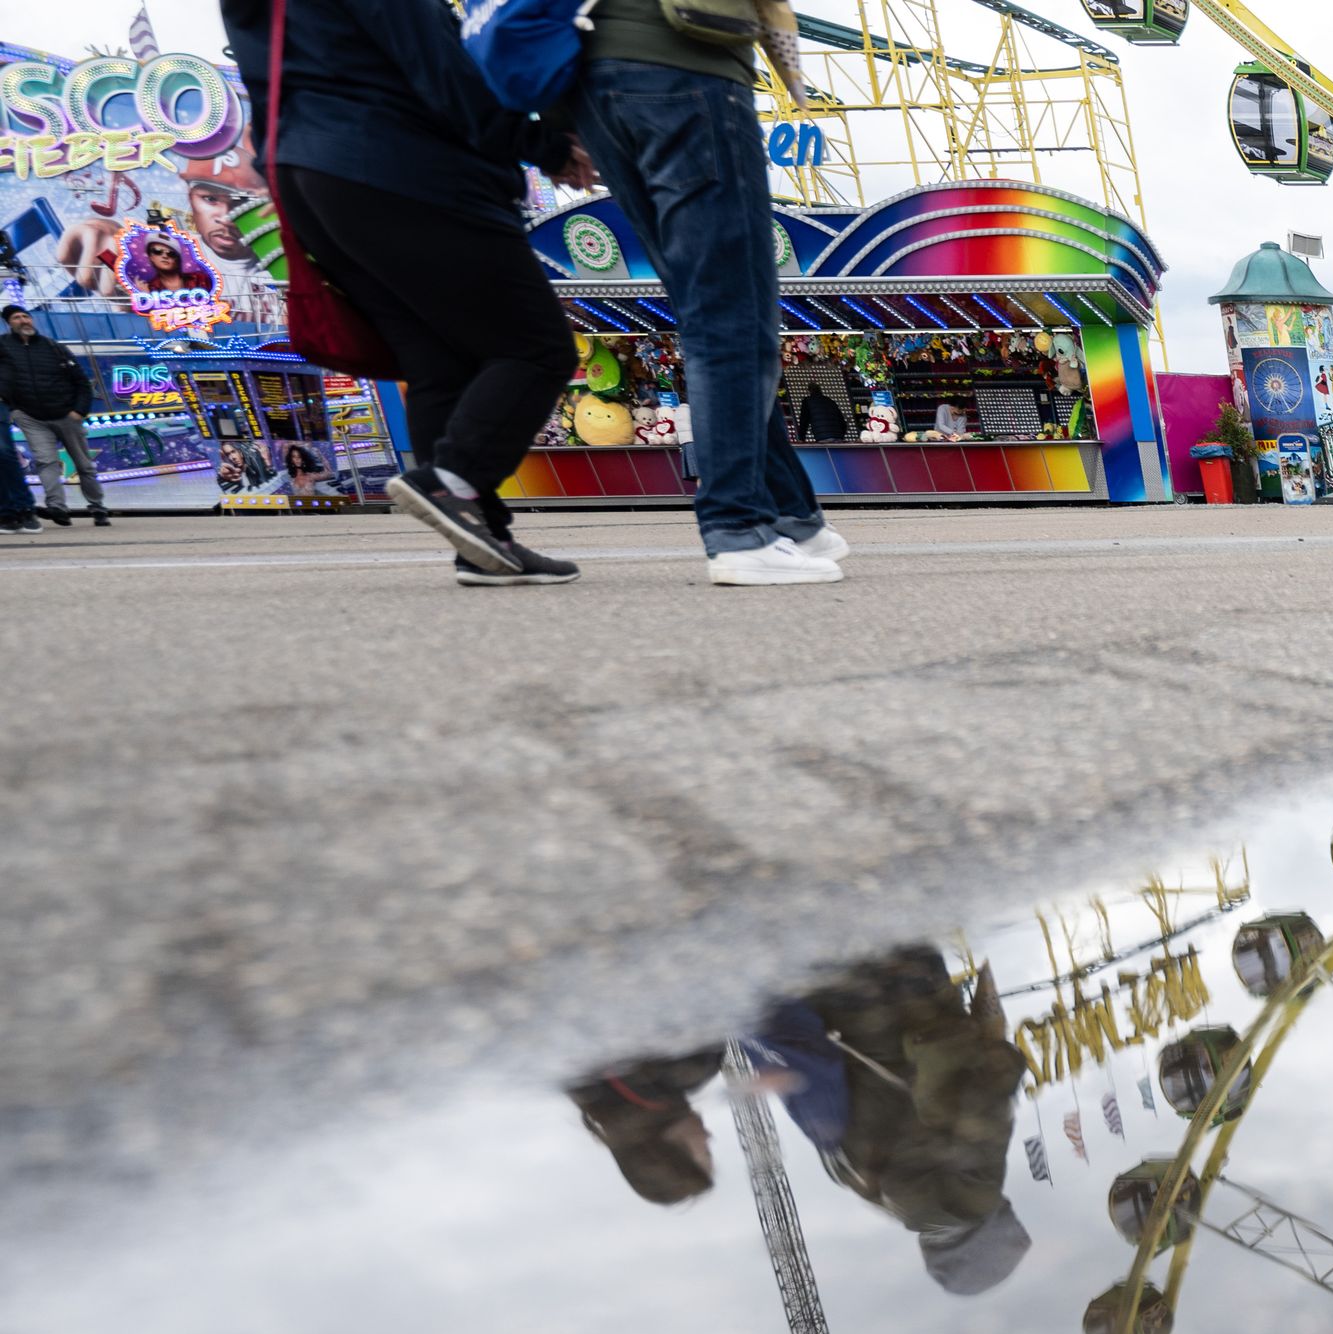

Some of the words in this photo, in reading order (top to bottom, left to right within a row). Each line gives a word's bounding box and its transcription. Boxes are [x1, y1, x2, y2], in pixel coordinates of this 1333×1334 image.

[768, 122, 823, 167] en
[132, 288, 211, 311] DISCO
[150, 301, 232, 331] FIEBER
[1258, 440, 1277, 451] MIL
